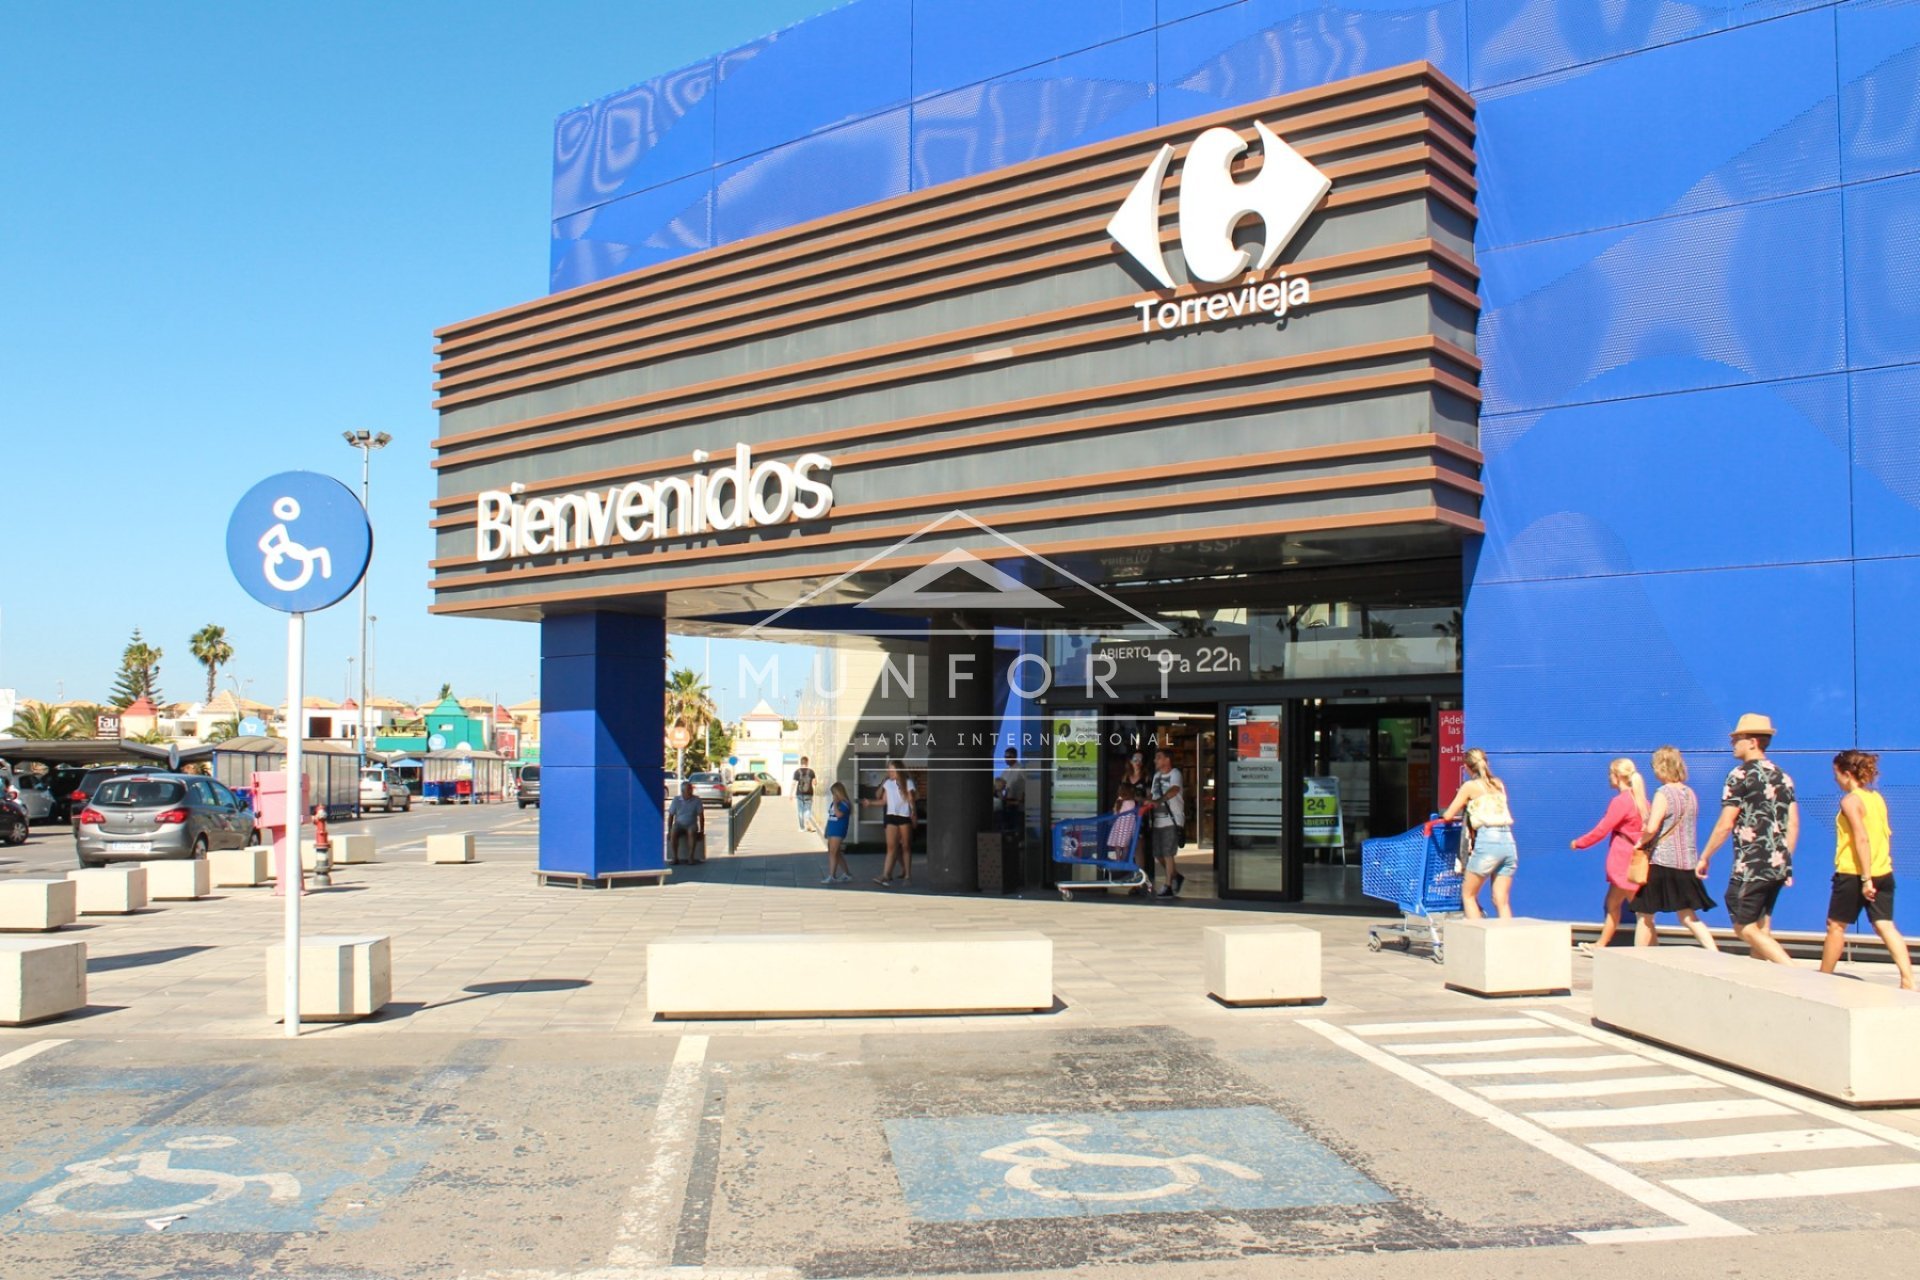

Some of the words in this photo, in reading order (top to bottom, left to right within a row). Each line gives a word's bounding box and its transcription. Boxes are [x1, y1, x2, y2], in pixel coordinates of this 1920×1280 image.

[1134, 271, 1310, 332] Torrevieja
[477, 442, 833, 561] Bienvenidos
[1100, 646, 1150, 660] ABIERTO
[1157, 649, 1174, 674] 9
[1179, 658, 1191, 673] a
[1196, 647, 1241, 673] 22h
[1441, 715, 1464, 726] ¡Adel
[1448, 727, 1461, 735] las
[1067, 744, 1087, 760] 24
[1306, 798, 1326, 811] 24
